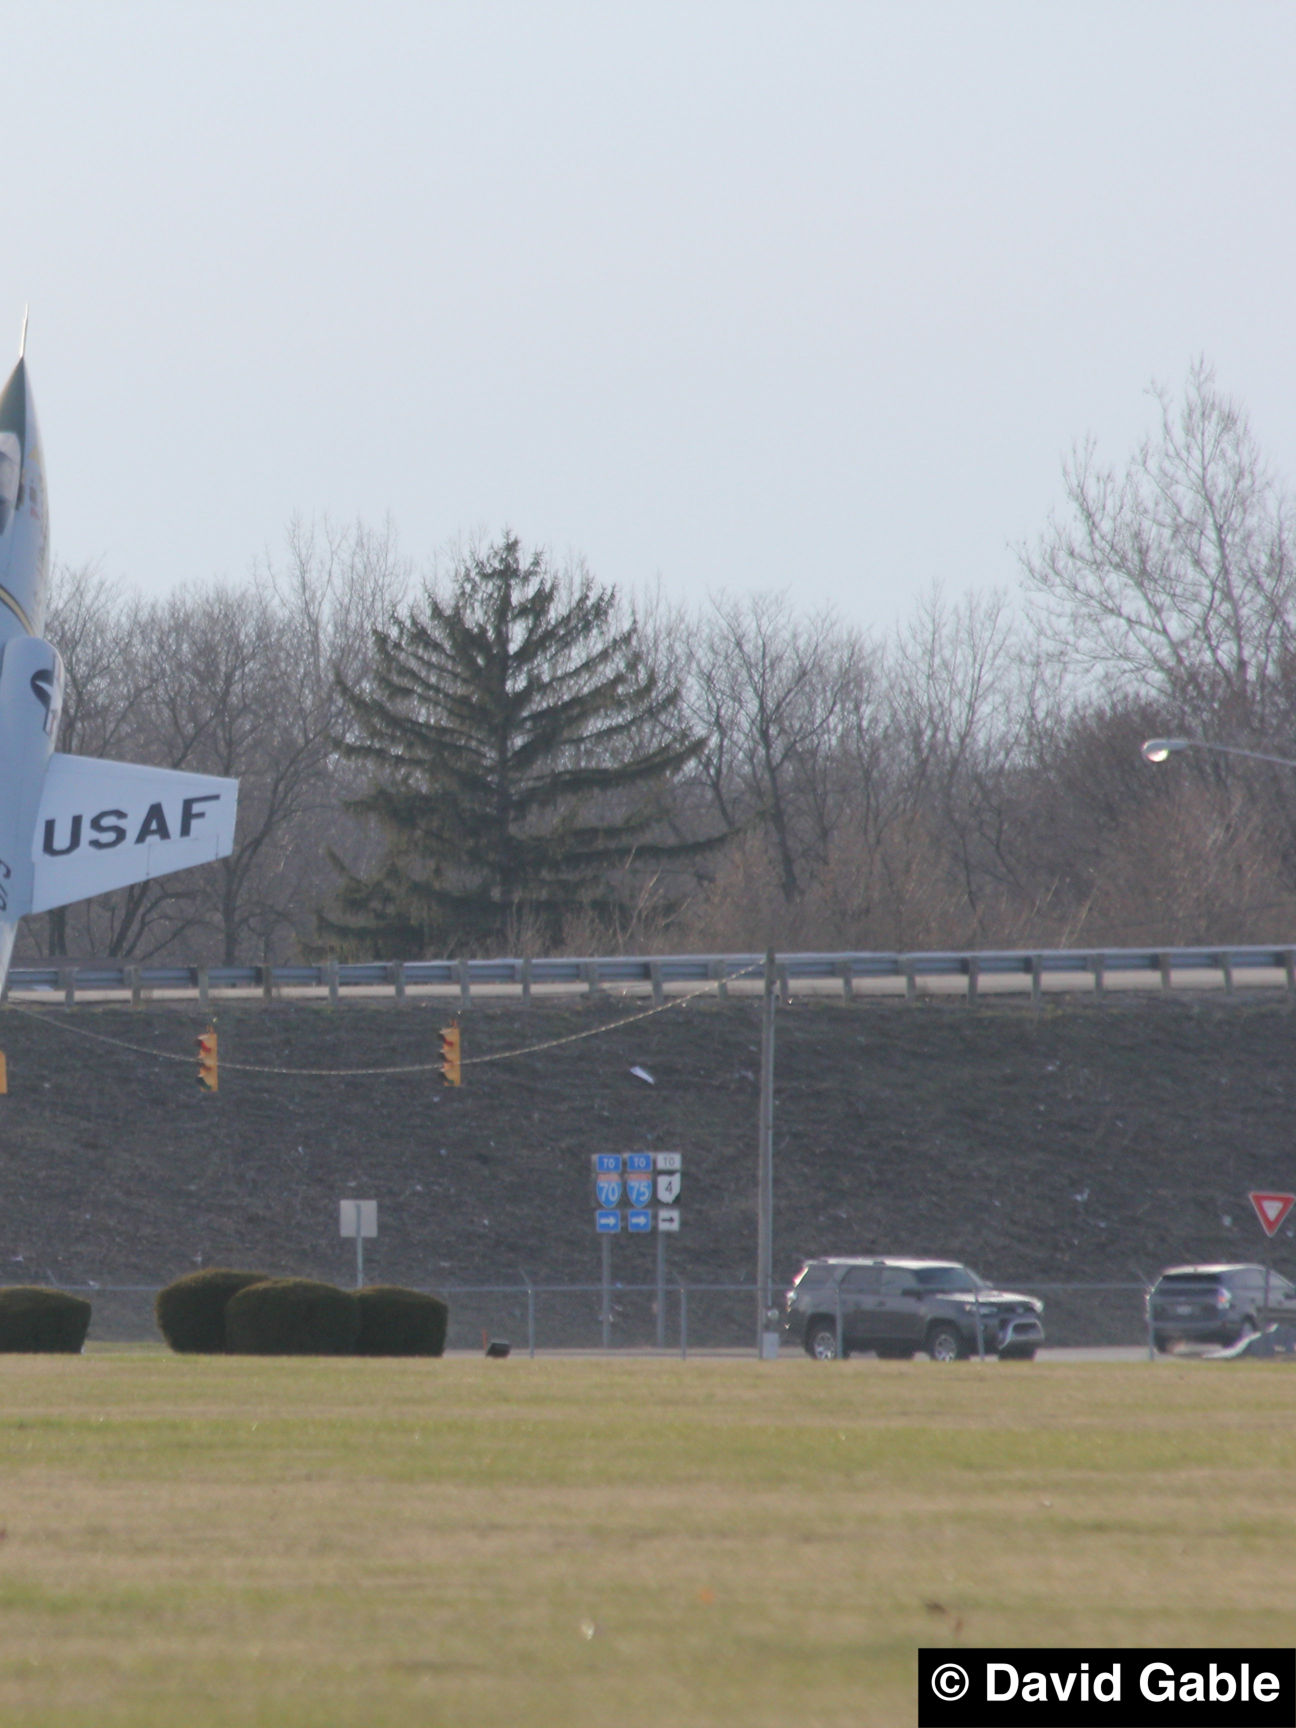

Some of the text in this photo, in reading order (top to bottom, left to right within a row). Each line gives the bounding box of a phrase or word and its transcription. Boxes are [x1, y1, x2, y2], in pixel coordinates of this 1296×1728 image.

[42, 794, 221, 857] USAF
[603, 1158, 616, 1169] TO
[633, 1157, 646, 1169] TO
[663, 1157, 676, 1168] TO
[599, 1182, 618, 1202] 70
[630, 1182, 649, 1201] 75
[665, 1181, 673, 1195] 4
